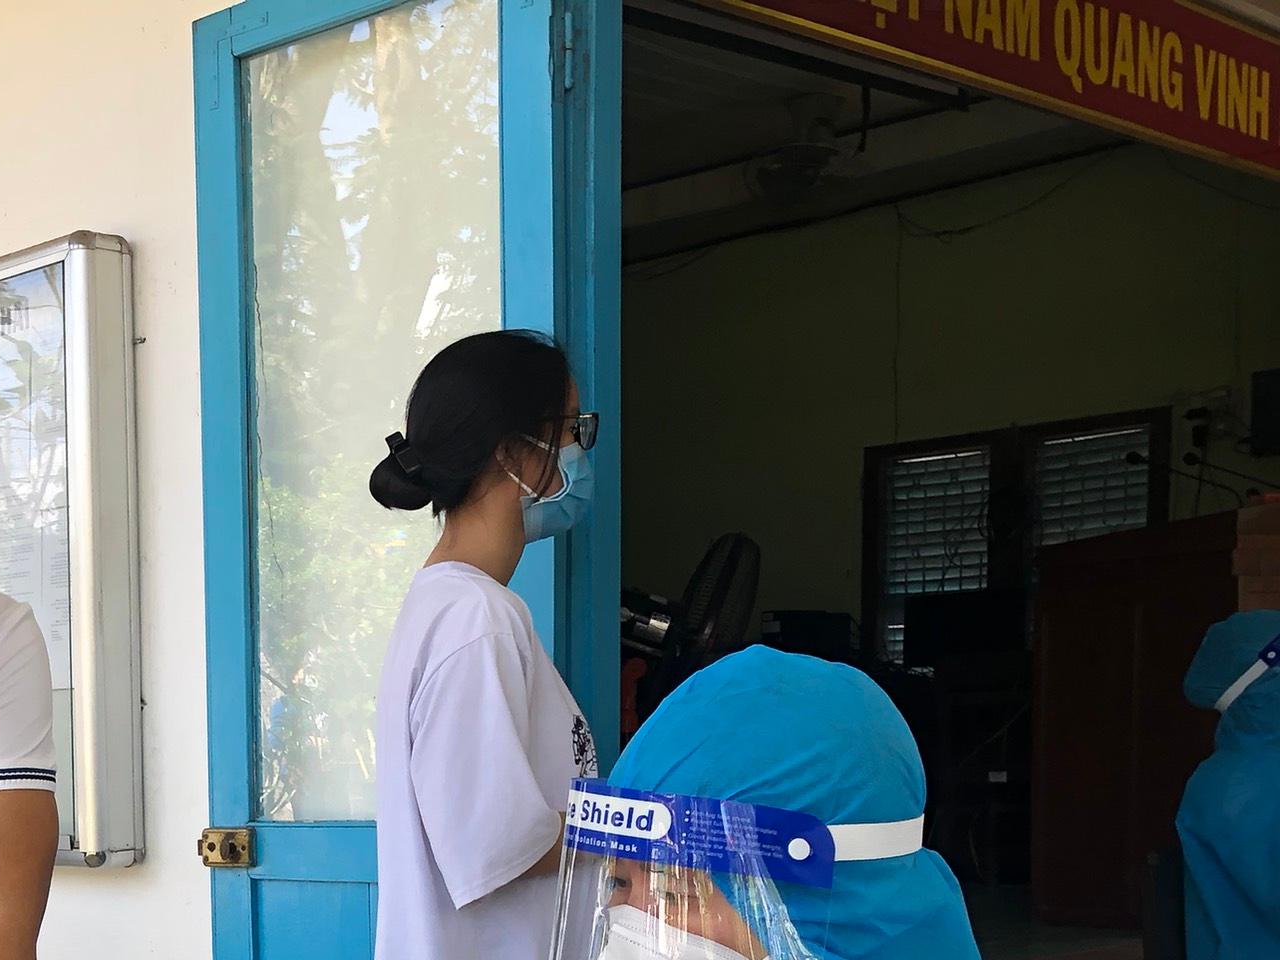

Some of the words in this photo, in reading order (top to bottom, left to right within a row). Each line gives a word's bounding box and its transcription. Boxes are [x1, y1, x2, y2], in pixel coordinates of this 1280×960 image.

[944, 0, 1040, 62] NAM
[1054, 2, 1185, 112] QUANG
[1195, 43, 1270, 141] VINH
[580, 799, 655, 832] Shield
[610, 840, 638, 853] Mask
